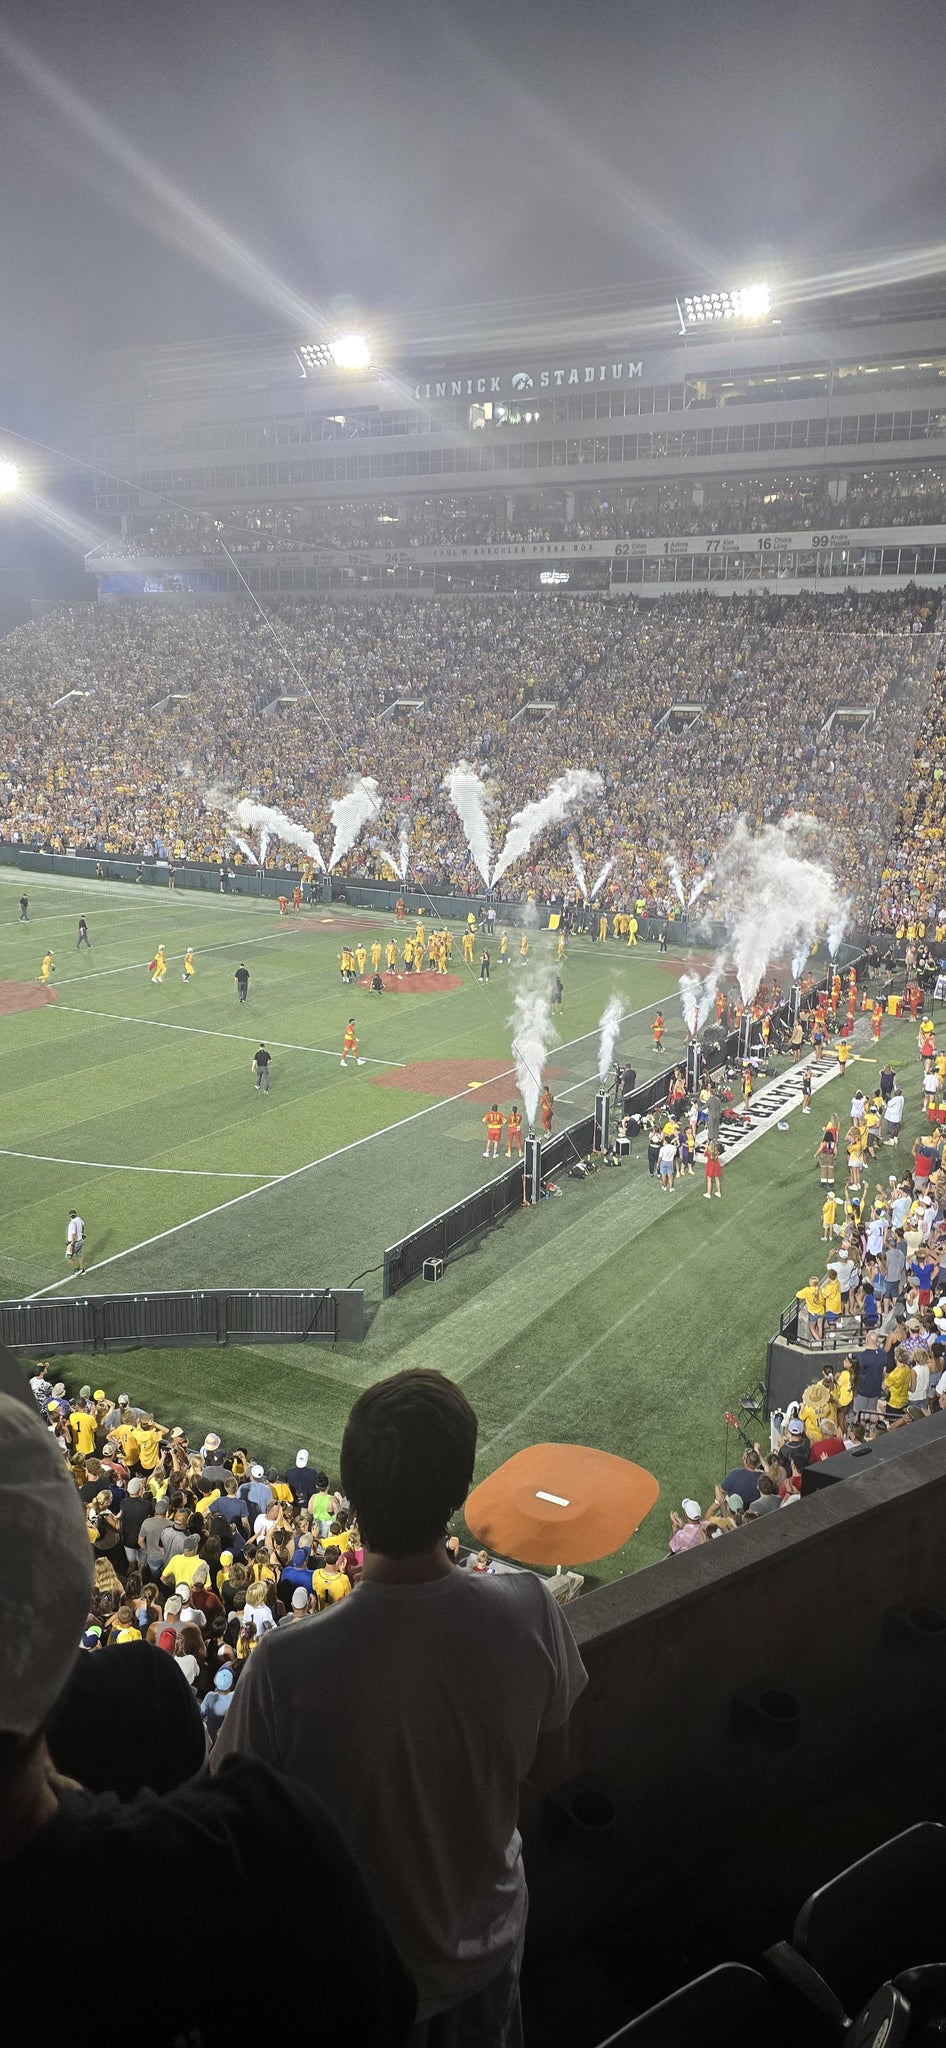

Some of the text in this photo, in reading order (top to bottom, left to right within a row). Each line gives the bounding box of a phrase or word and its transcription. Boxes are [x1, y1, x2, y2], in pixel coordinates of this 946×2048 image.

[540, 361, 644, 387] STADIUM
[573, 543, 594, 551] BOX
[705, 540, 721, 552] 77
[757, 538, 772, 550] 16
[812, 535, 829, 547] 99
[614, 544, 630, 555] 62
[664, 542, 669, 553] 1
[76, 1421, 81, 1433] 1
[323, 1588, 330, 1603] 1
